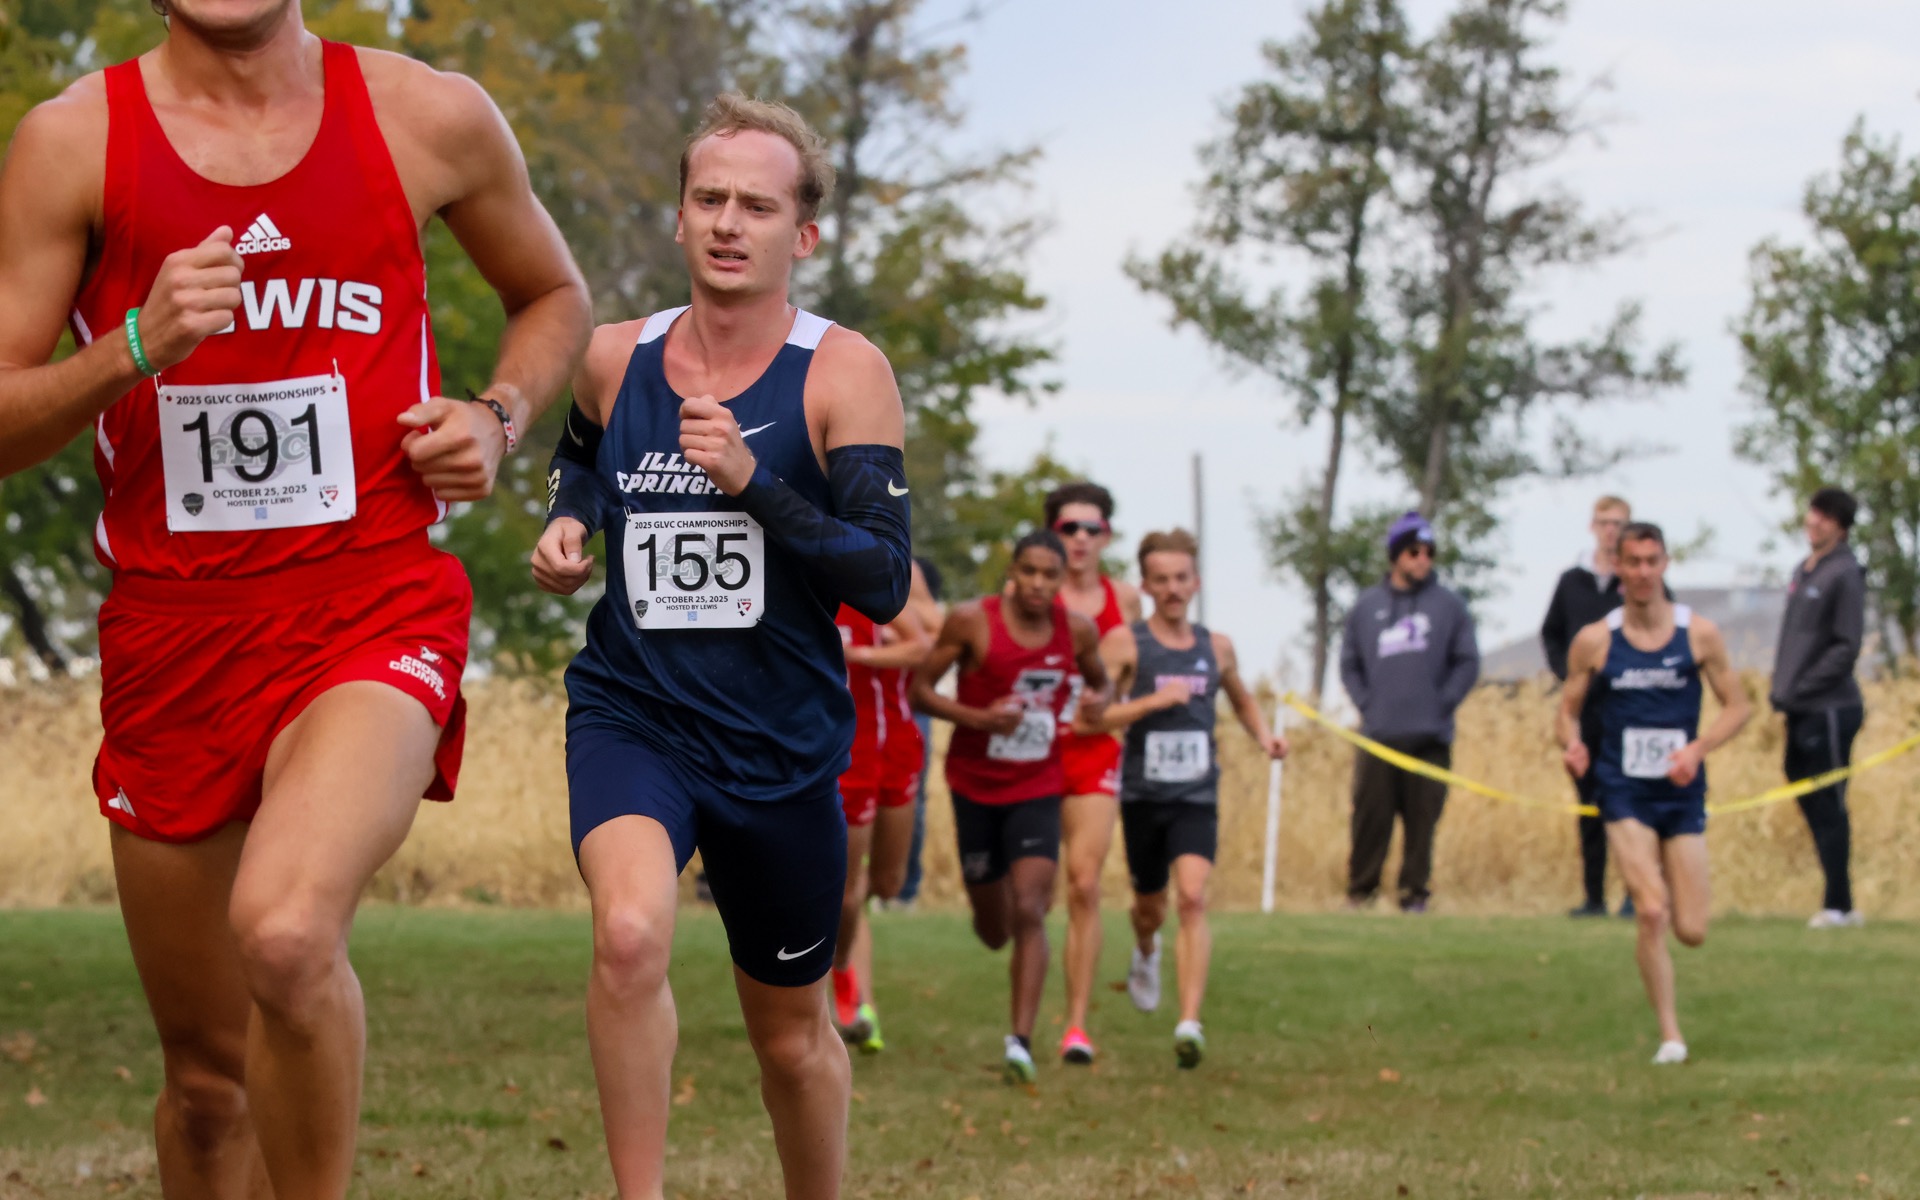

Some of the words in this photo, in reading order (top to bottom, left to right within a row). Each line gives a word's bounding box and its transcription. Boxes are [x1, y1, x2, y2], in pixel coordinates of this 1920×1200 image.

[235, 237, 291, 255] adidas
[208, 278, 382, 335] WIS
[176, 396, 202, 405] 2025
[204, 394, 232, 405] GLVC
[235, 386, 326, 403] CHAMPIONSHIPS
[183, 403, 322, 483] 191
[213, 488, 262, 499] OCTOBER
[264, 487, 280, 498] 25,
[282, 484, 308, 495] 2025
[227, 499, 257, 507] HOSTED
[259, 498, 269, 506] BY
[271, 496, 294, 505] LEWIS
[635, 521, 652, 529] 2025
[654, 521, 675, 529] GLVC
[677, 520, 748, 528] CHAMPIONSHIPS
[637, 533, 751, 591] 155
[655, 596, 693, 604] OCTOBER
[695, 596, 708, 604] 25,
[389, 660, 446, 701] COUNTRY
[401, 655, 444, 688] CROSS
